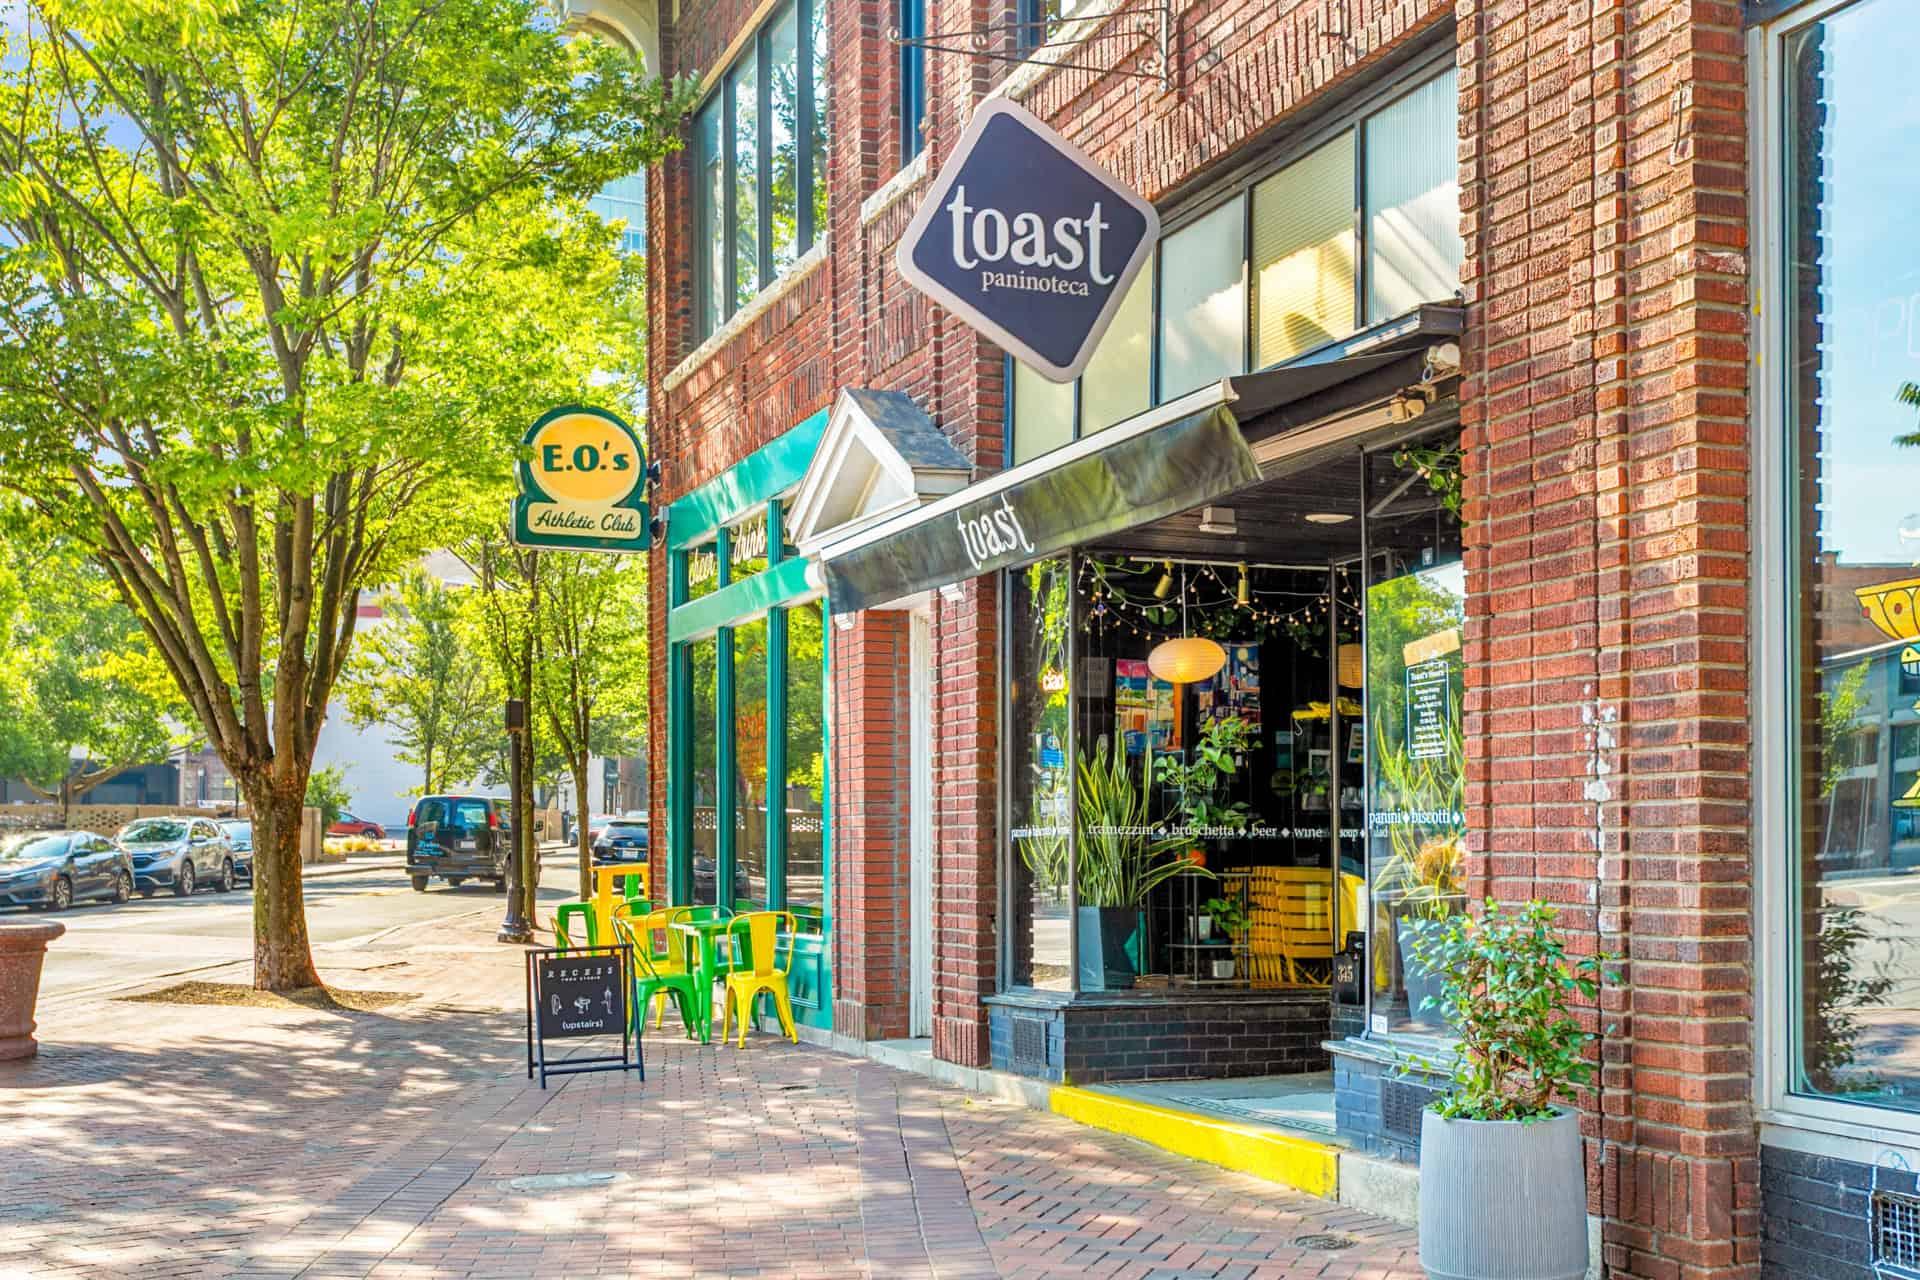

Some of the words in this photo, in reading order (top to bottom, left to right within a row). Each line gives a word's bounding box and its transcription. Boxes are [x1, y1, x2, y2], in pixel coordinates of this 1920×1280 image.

[946, 184, 1116, 285] toast
[981, 269, 1089, 297] paninoteca
[543, 441, 630, 472] E.O.'s
[534, 509, 595, 530] Athletic
[600, 513, 636, 532] Club
[957, 490, 1035, 571] toast
[1368, 808, 1401, 830] panini
[1411, 807, 1450, 824] biscotti
[1172, 823, 1235, 837] bruschetta
[1251, 823, 1278, 837] beer
[1294, 827, 1323, 839] wine
[1339, 828, 1359, 841] soup
[547, 966, 614, 979] RECESS
[1338, 964, 1353, 983] 345
[562, 1018, 604, 1030] (upstairs)
